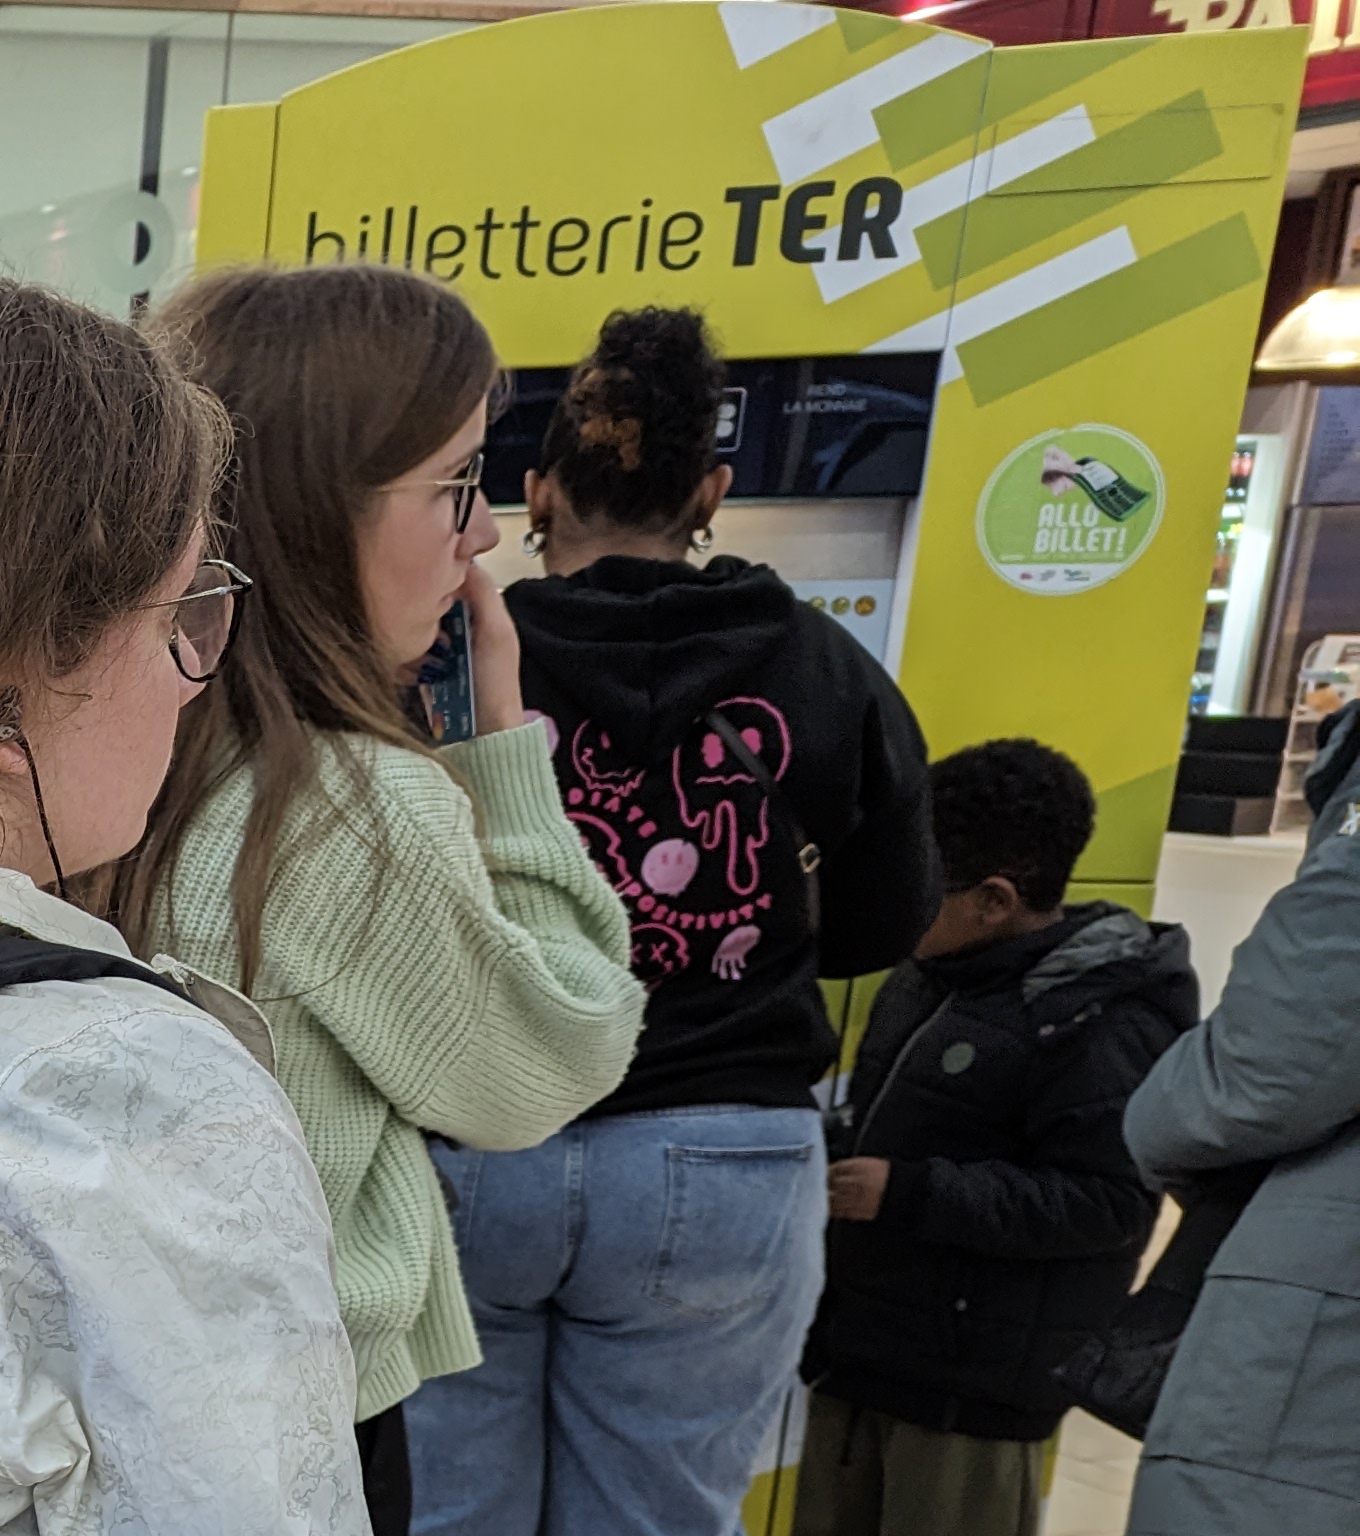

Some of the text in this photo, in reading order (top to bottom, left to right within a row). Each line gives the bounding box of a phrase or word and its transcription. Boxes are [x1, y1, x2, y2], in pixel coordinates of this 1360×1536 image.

[305, 177, 904, 282] billetterie TER
[1037, 503, 1100, 528] ALLO
[1033, 527, 1127, 559] BILLET!
